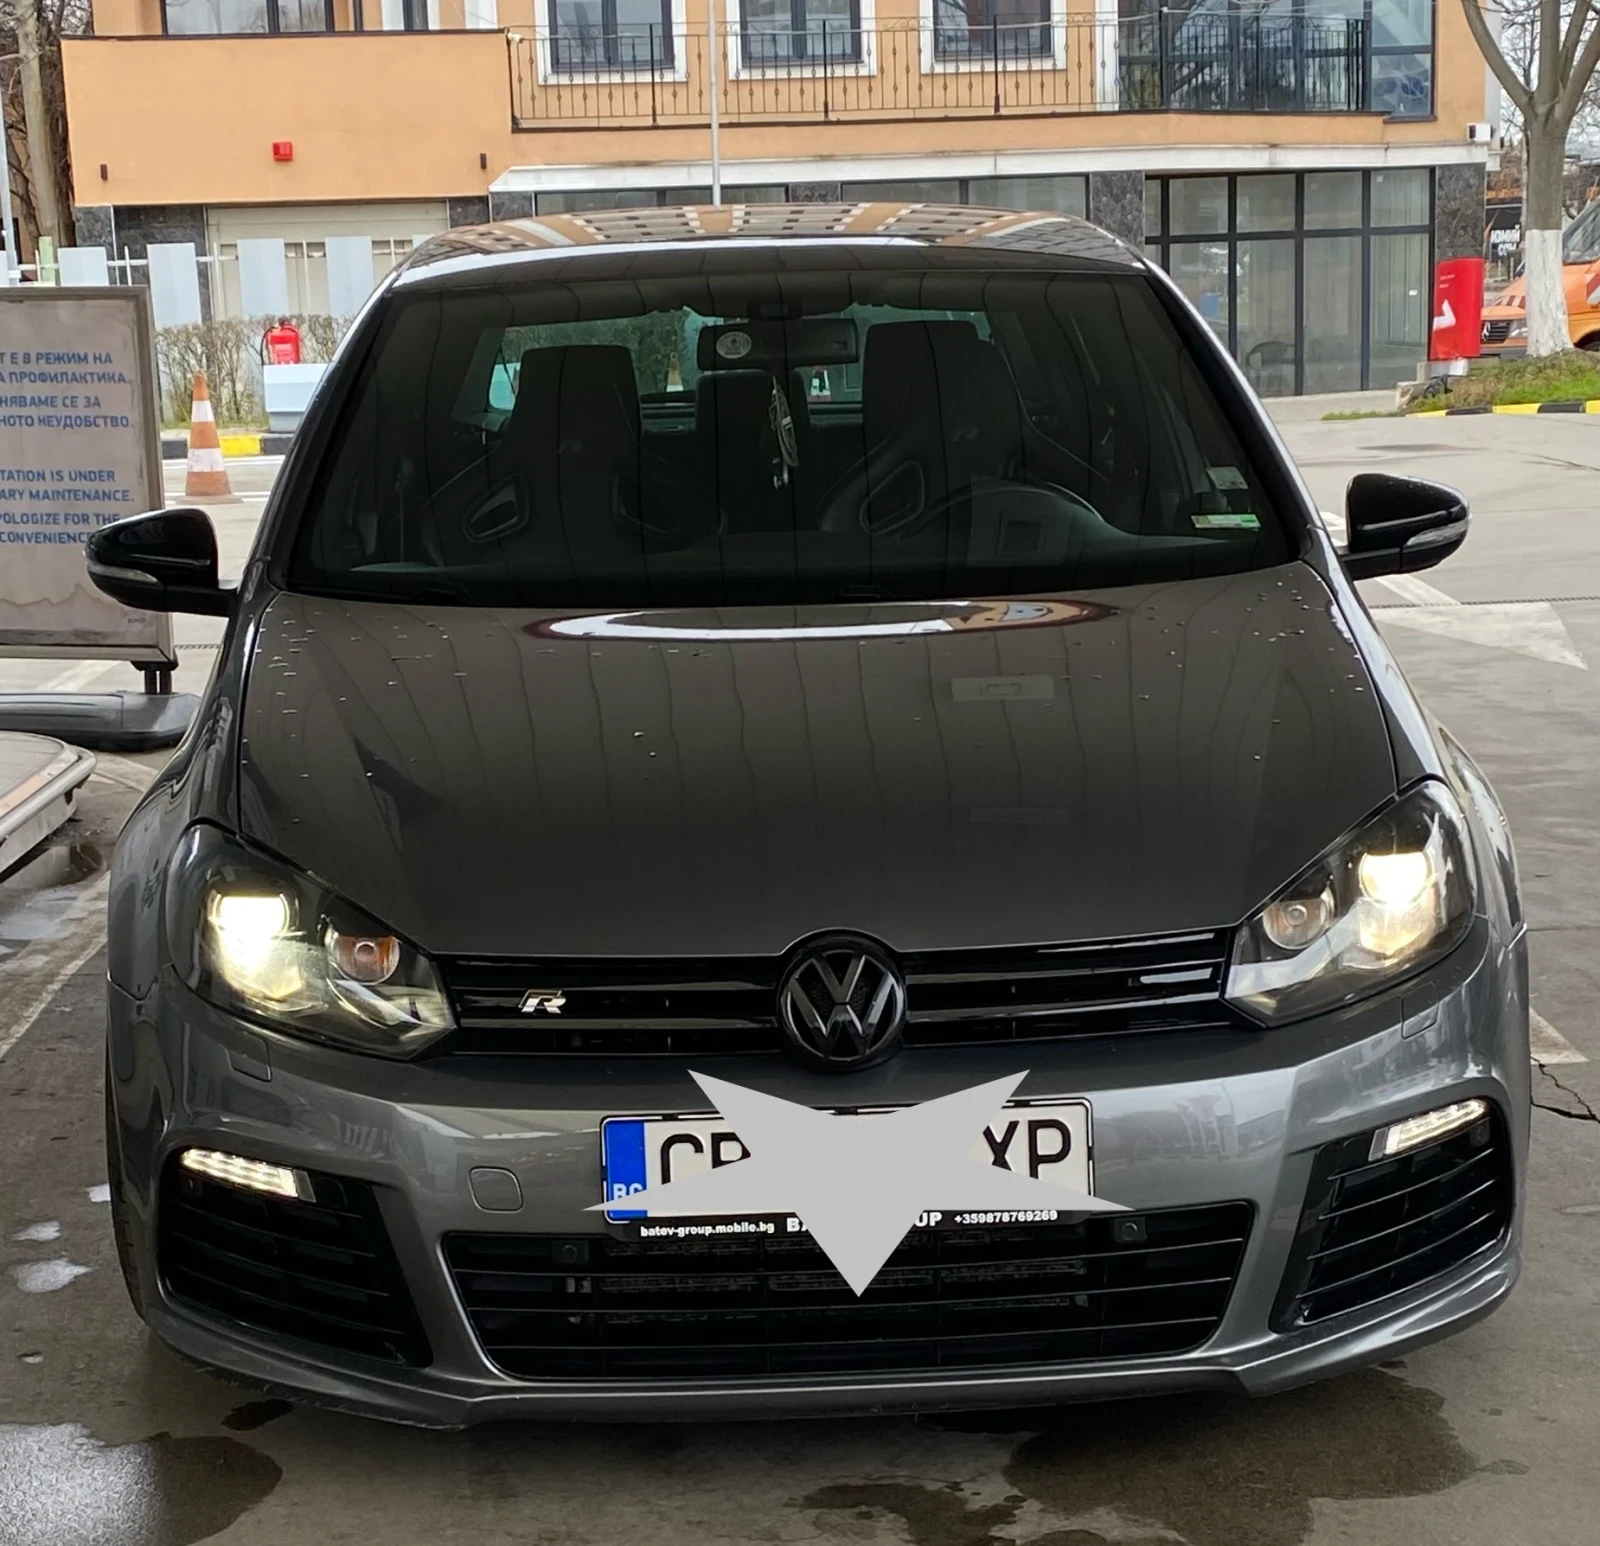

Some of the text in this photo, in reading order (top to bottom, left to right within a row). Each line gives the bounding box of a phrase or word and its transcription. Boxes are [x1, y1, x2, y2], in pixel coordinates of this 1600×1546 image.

[10, 352, 18, 365] Е
[23, 352, 31, 364] В
[36, 352, 89, 365] РЕЖИМ
[93, 353, 113, 364] НА
[62, 396, 79, 408] СЕ
[83, 396, 101, 408] ЗА
[51, 470, 64, 482] IS
[68, 470, 116, 482] UNDER
[64, 513, 91, 525] FOR
[518, 989, 566, 1014] R
[640, 1221, 775, 1238] batev-group.mobile.bg
[954, 1209, 1058, 1224] +359878769269
